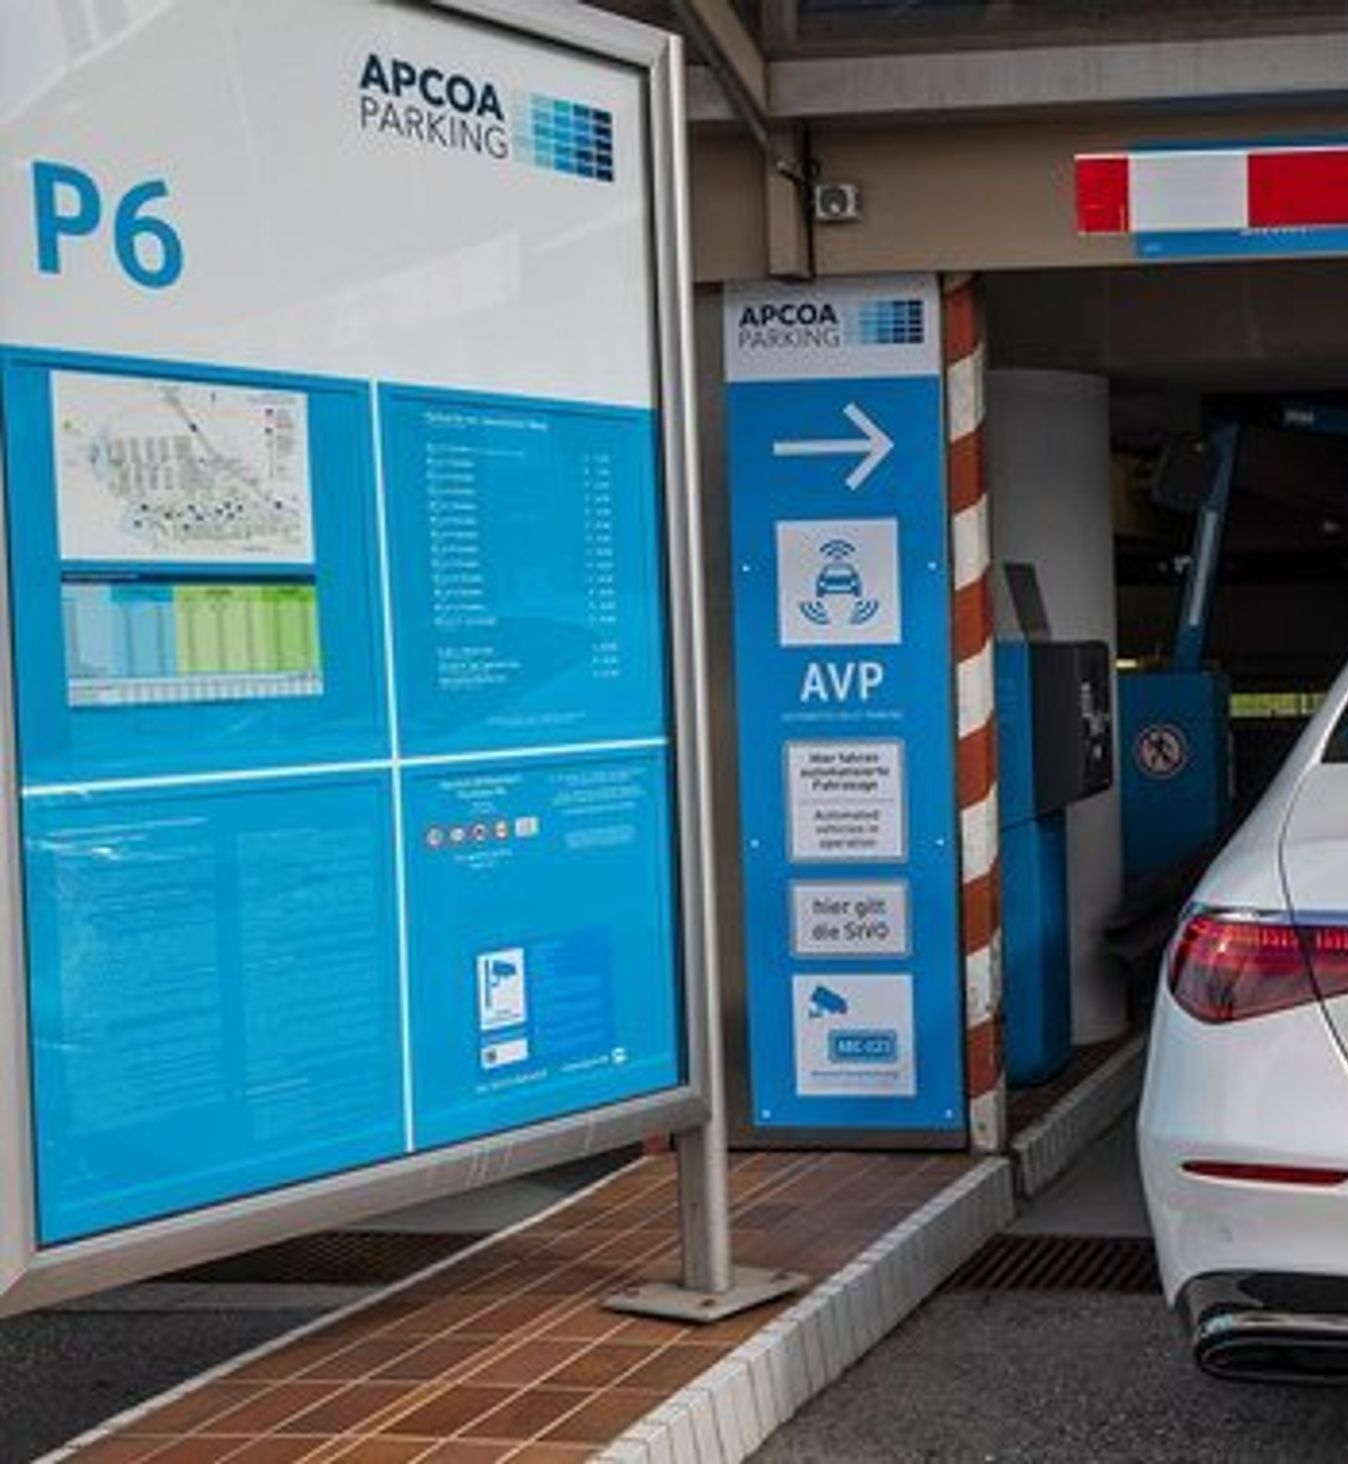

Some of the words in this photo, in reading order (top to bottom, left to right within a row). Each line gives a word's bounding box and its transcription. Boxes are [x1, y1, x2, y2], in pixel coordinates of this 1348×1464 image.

[359, 53, 504, 121] APCOA
[361, 96, 509, 159] PARKING
[33, 160, 183, 289] P6
[739, 303, 839, 326] APCOA
[739, 326, 840, 348] PARKING
[800, 662, 884, 702] AVP
[812, 898, 849, 914] hier
[855, 898, 887, 919] gilt
[812, 924, 840, 942] die
